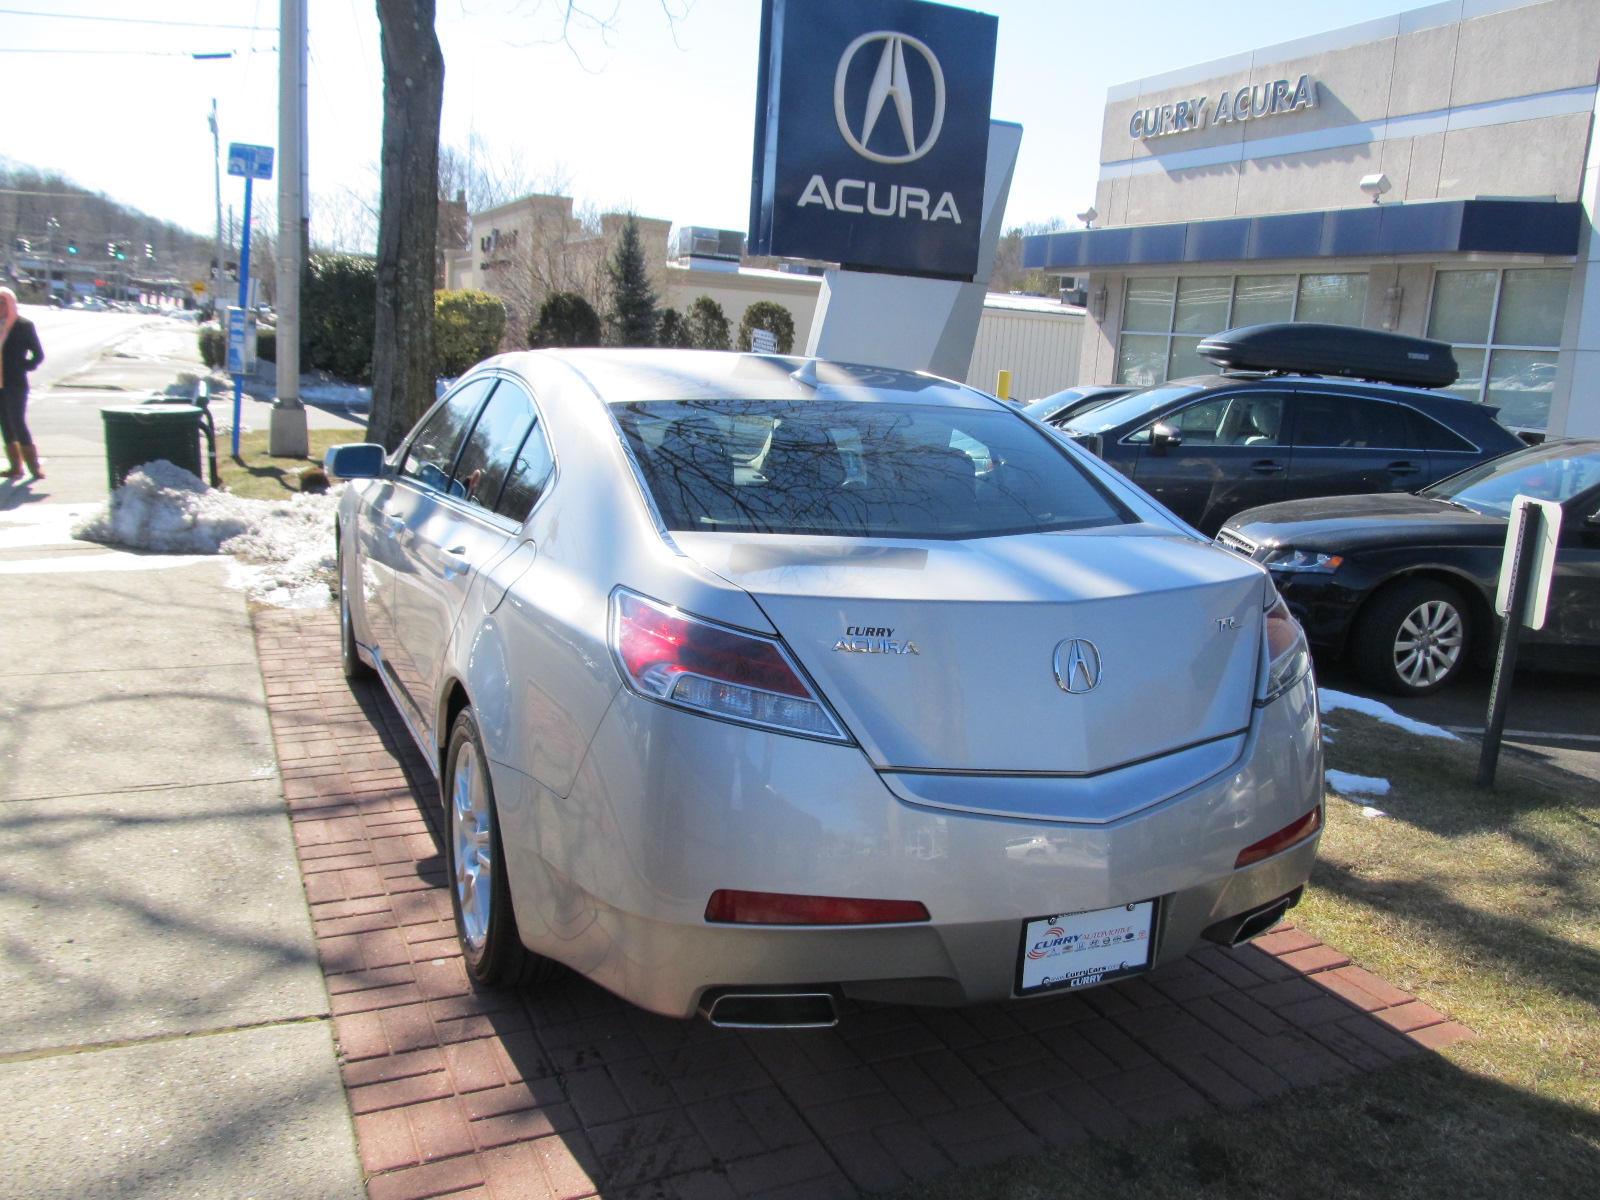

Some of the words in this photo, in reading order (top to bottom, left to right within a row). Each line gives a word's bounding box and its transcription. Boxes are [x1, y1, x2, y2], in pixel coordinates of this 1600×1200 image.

[1129, 96, 1208, 139] CURRY
[1212, 73, 1316, 126] ACURA
[796, 174, 962, 224] ACURA
[846, 626, 896, 638] CURRY
[831, 636, 921, 656] ACURA
[1034, 933, 1083, 951] CURRY
[1082, 926, 1133, 940] AUTOMOTIVE
[1070, 973, 1102, 987] CURRY
